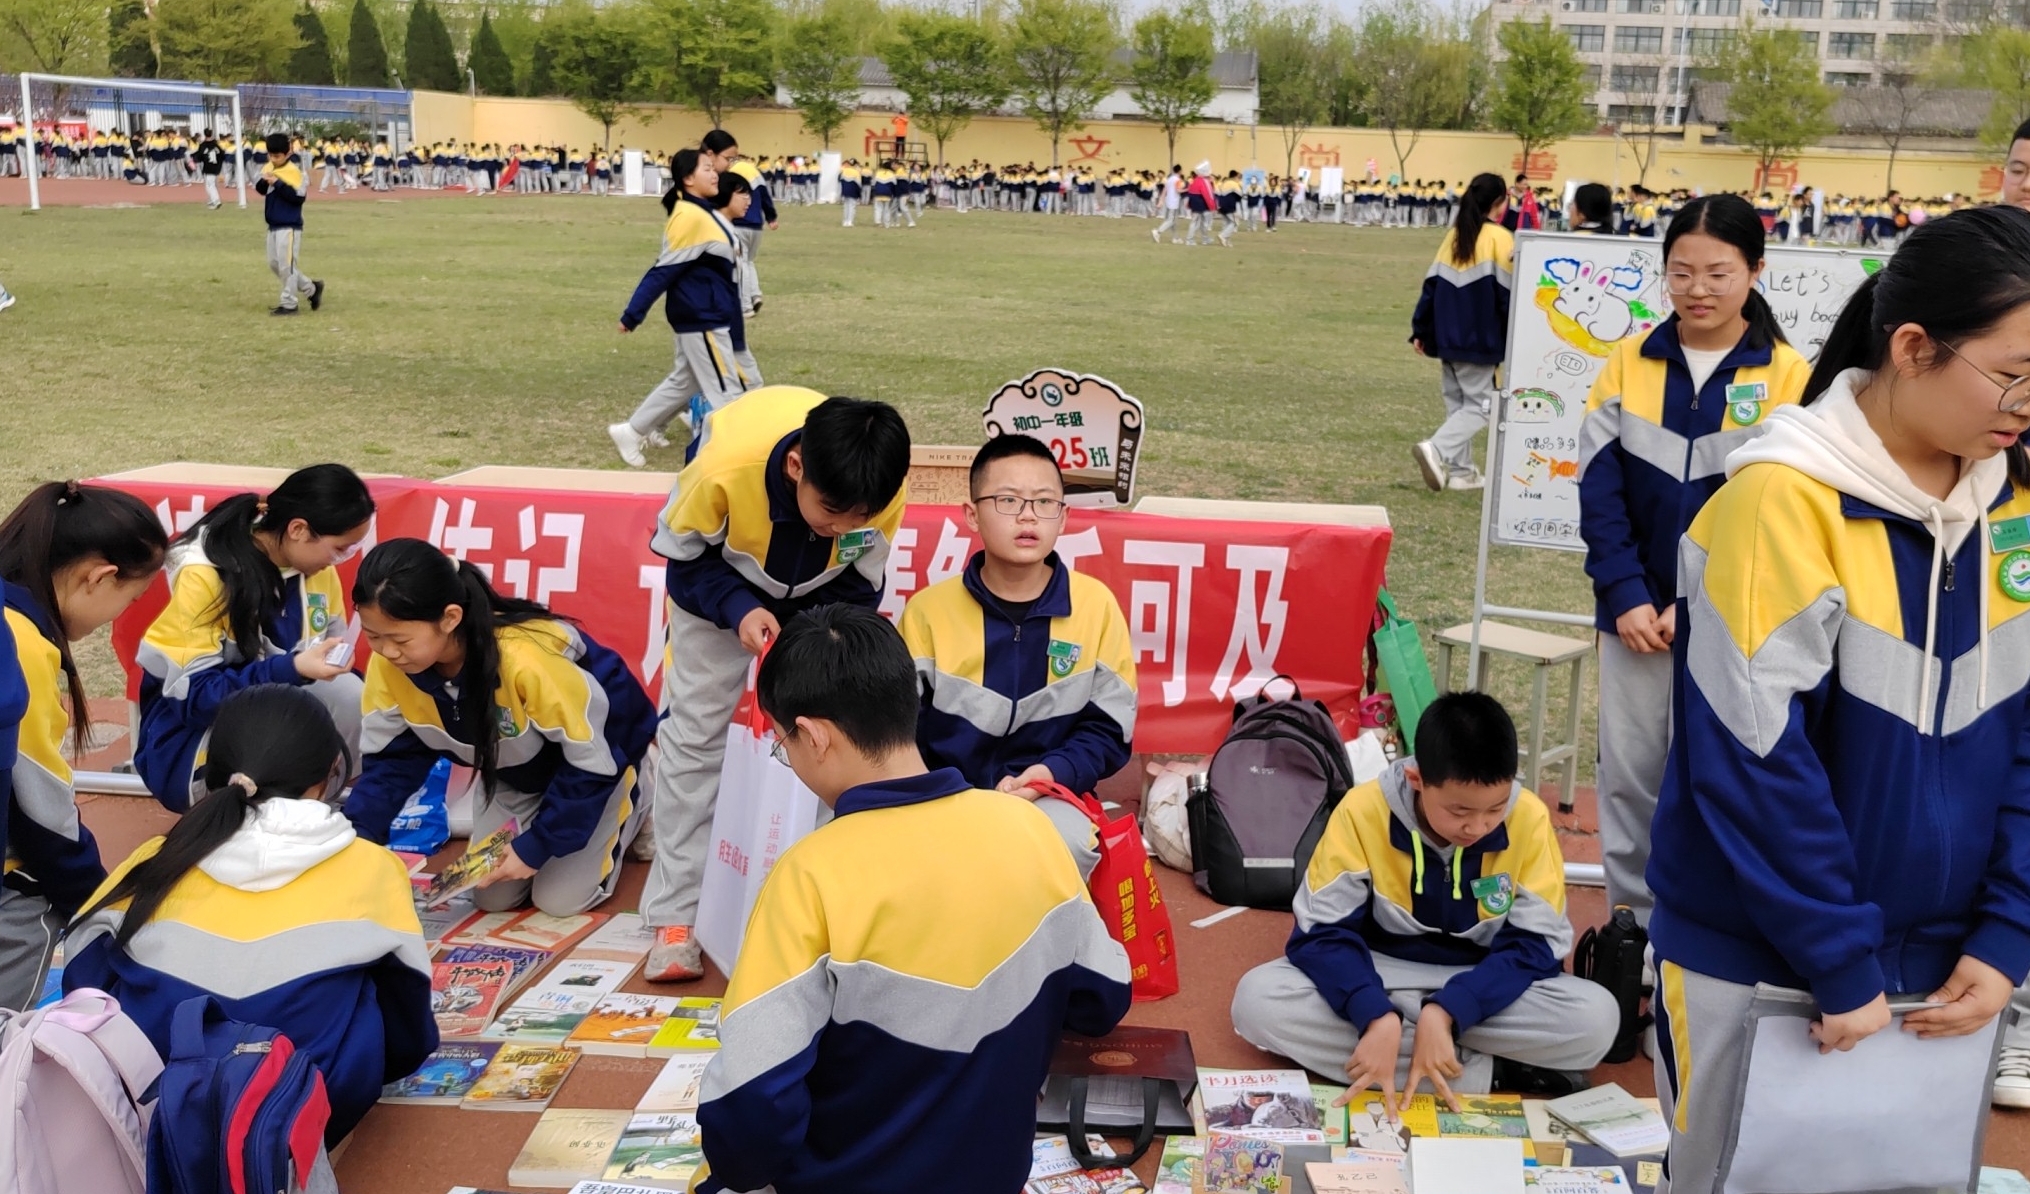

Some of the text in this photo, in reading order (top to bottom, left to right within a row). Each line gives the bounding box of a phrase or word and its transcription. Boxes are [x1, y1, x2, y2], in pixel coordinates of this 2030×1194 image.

[1067, 134, 1111, 165] 文
[1753, 158, 1798, 192] 尚
[1769, 269, 1830, 296] Let's
[1810, 302, 1841, 323] boo
[1012, 411, 1085, 431] 初中一年级
[928, 453, 974, 461] NIKE TRA
[1513, 521, 1580, 538] 欢迎同学
[1205, 1074, 1278, 1086] 半月选读
